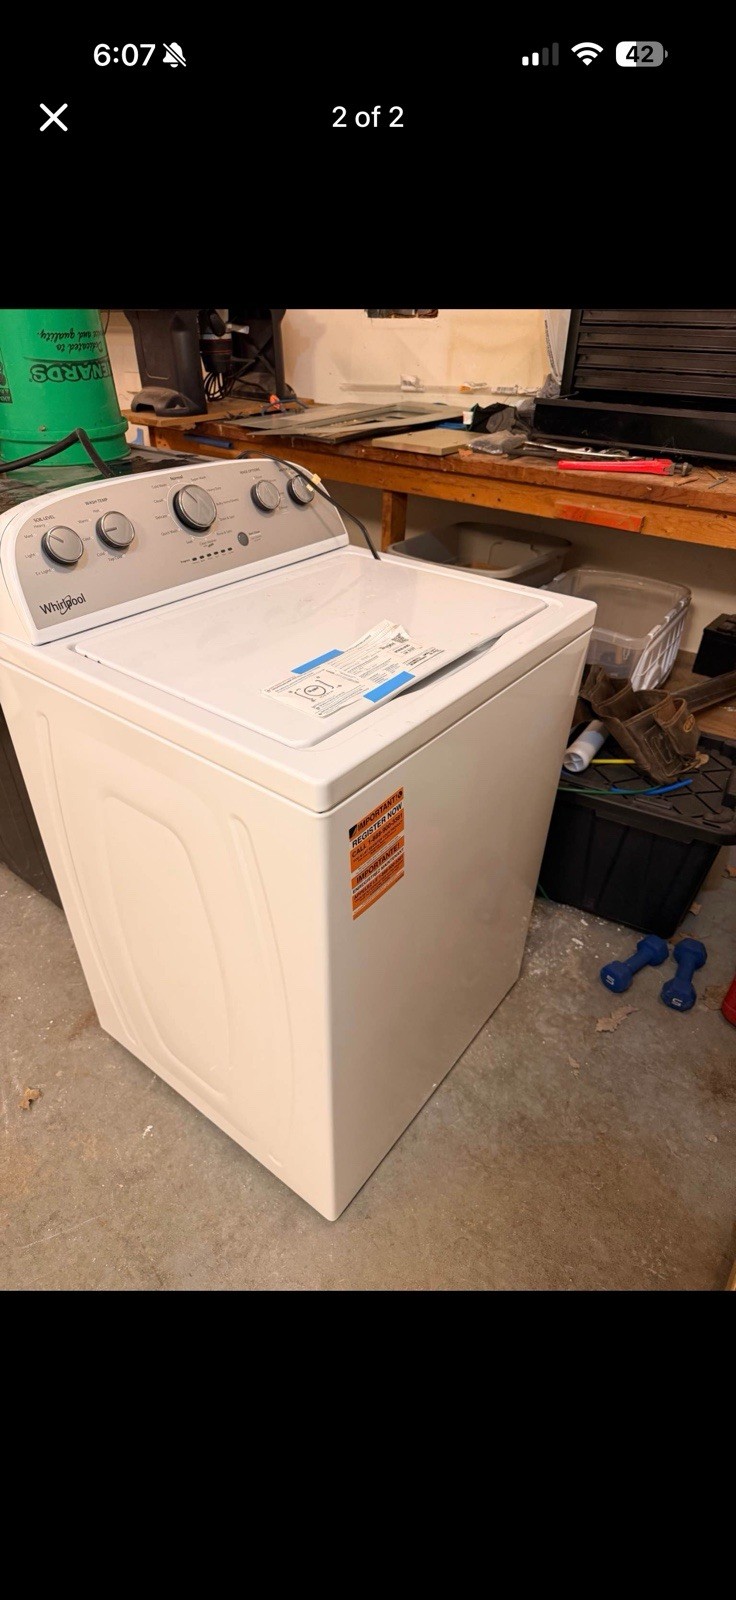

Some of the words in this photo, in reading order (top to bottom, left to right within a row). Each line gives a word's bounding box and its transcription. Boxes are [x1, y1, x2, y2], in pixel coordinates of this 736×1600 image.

[56, 342, 66, 351] to
[39, 593, 86, 615] Whirlpool
[352, 816, 386, 848] REGISTER
[387, 801, 403, 820] NOW
[351, 843, 367, 858] CALL
[356, 842, 400, 884] IMPORTANTE!
